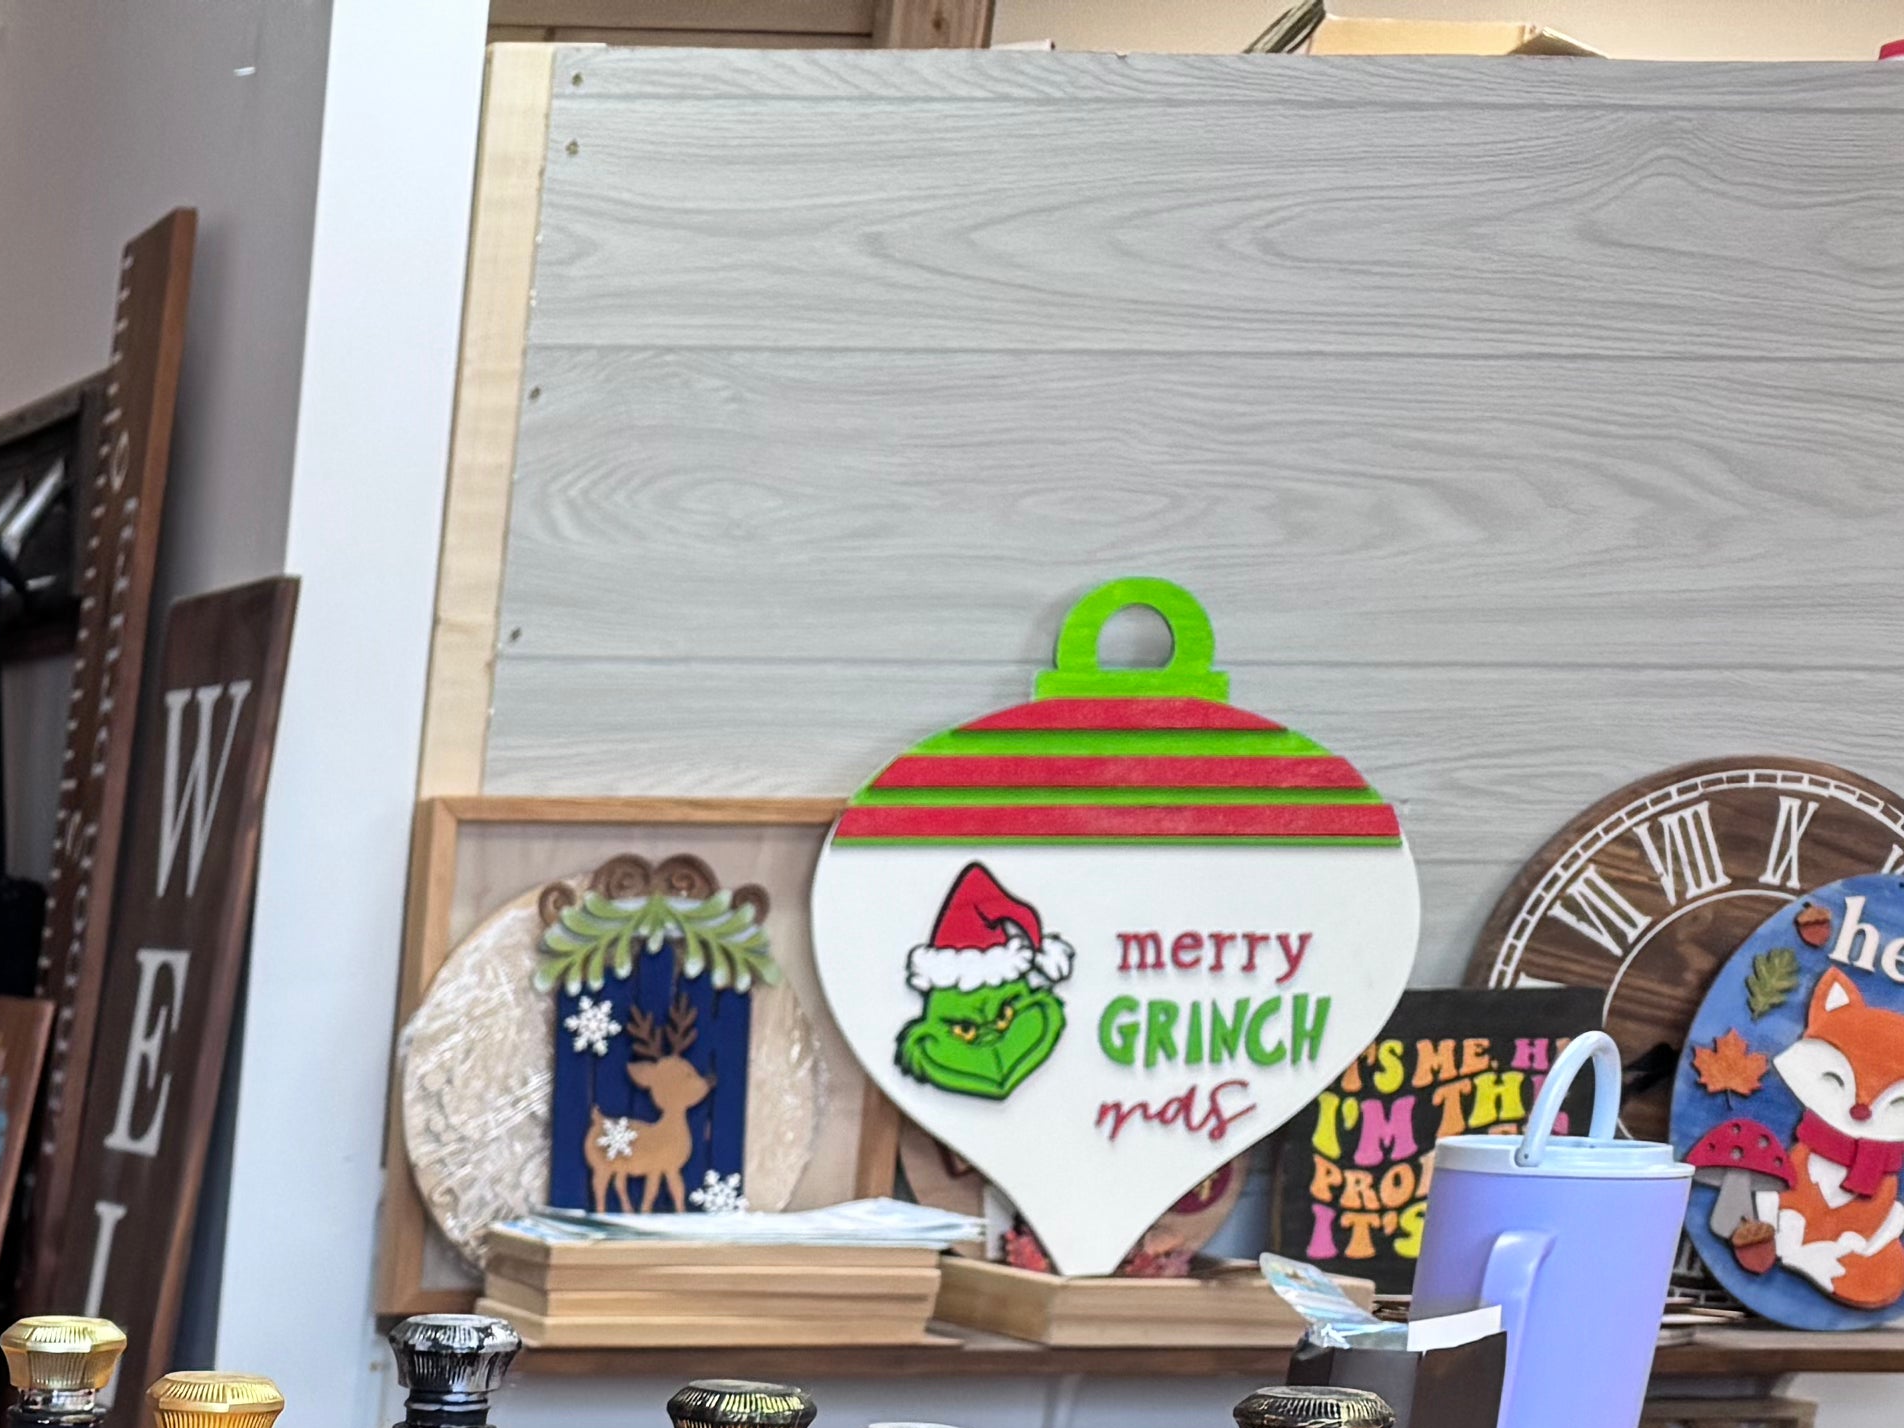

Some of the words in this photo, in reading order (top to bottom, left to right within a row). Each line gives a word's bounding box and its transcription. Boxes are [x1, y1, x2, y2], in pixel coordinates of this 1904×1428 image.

[1116, 929, 1314, 984] merry
[1097, 993, 1332, 1068] GRINCH
[1510, 1037, 1573, 1071] H
[1094, 1079, 1258, 1142] mas
[1311, 1090, 1419, 1168] I'M
